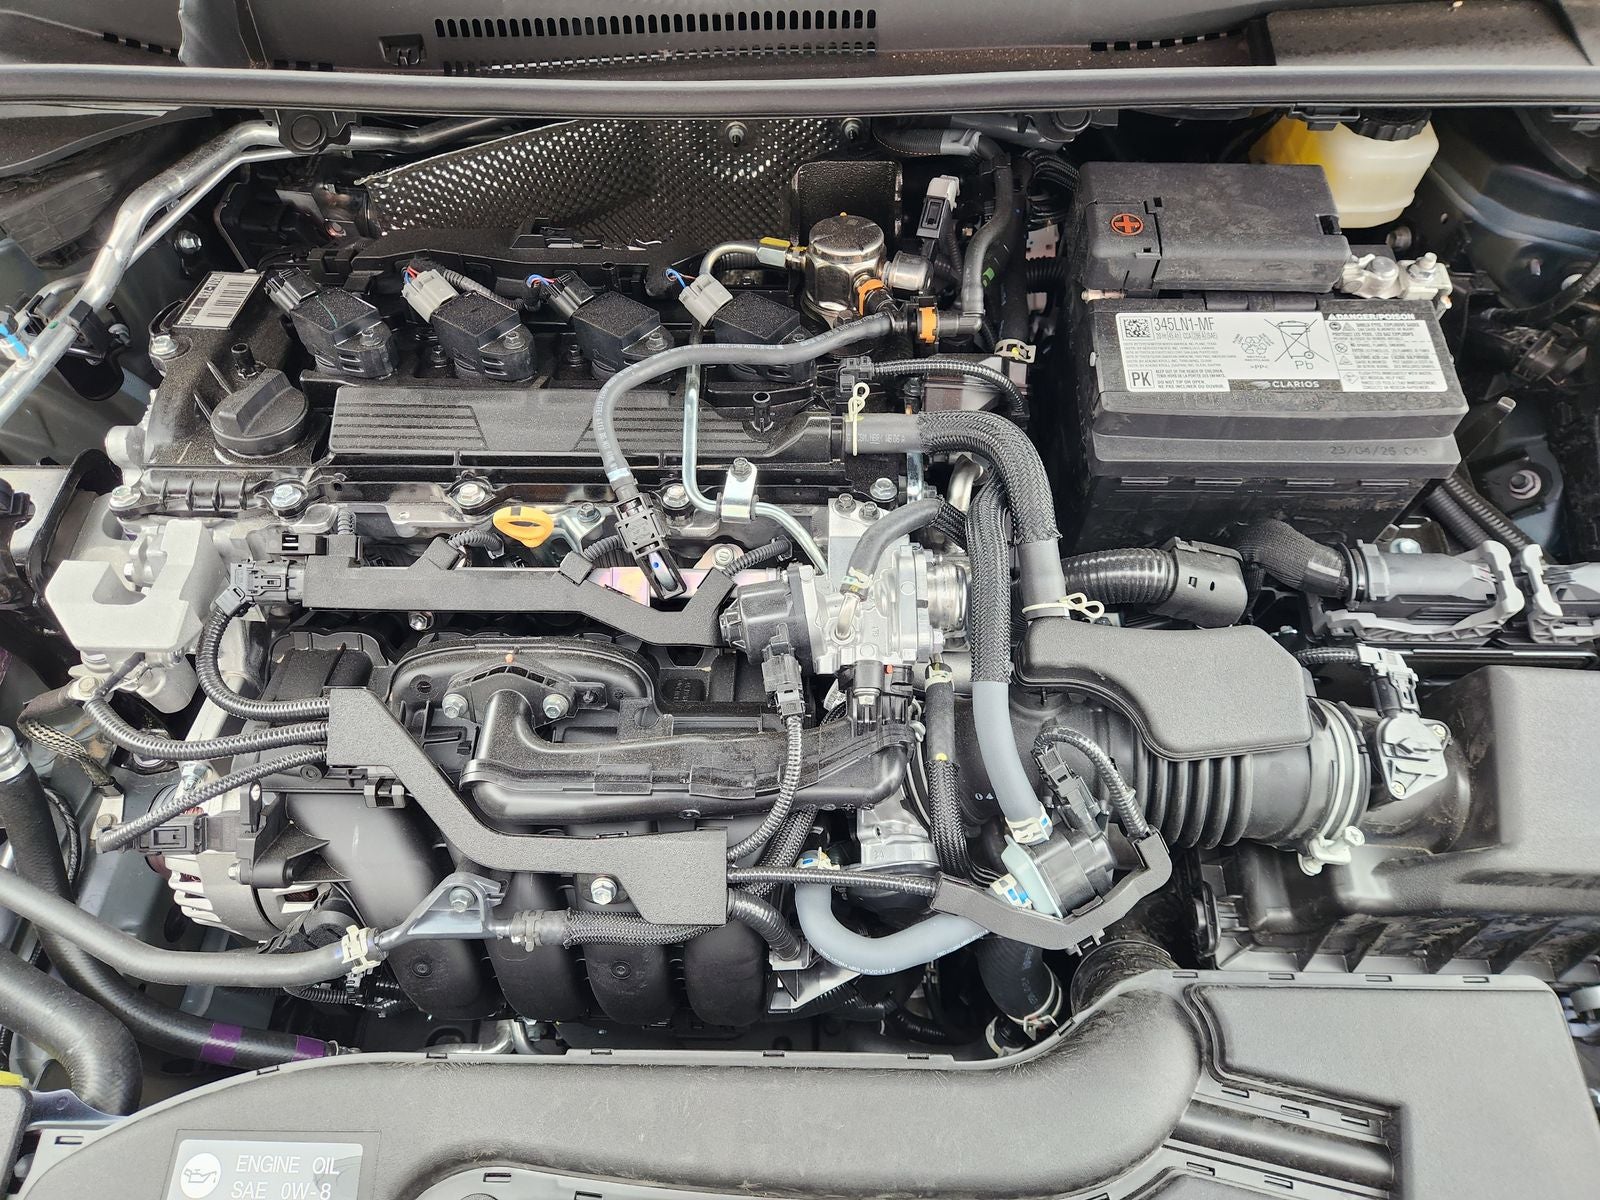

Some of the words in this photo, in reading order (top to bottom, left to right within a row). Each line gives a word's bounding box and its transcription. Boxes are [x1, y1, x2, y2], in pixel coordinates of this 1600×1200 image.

[1153, 316, 1215, 331] 345LN1-MF
[1295, 361, 1313, 370] Pb
[1132, 371, 1152, 387] PK
[1272, 380, 1320, 388] CLARIOS
[236, 1154, 301, 1174] ENGINE
[312, 1156, 340, 1175] OIL
[231, 1180, 268, 1200] SAE
[280, 1182, 331, 1200] 0W-8
